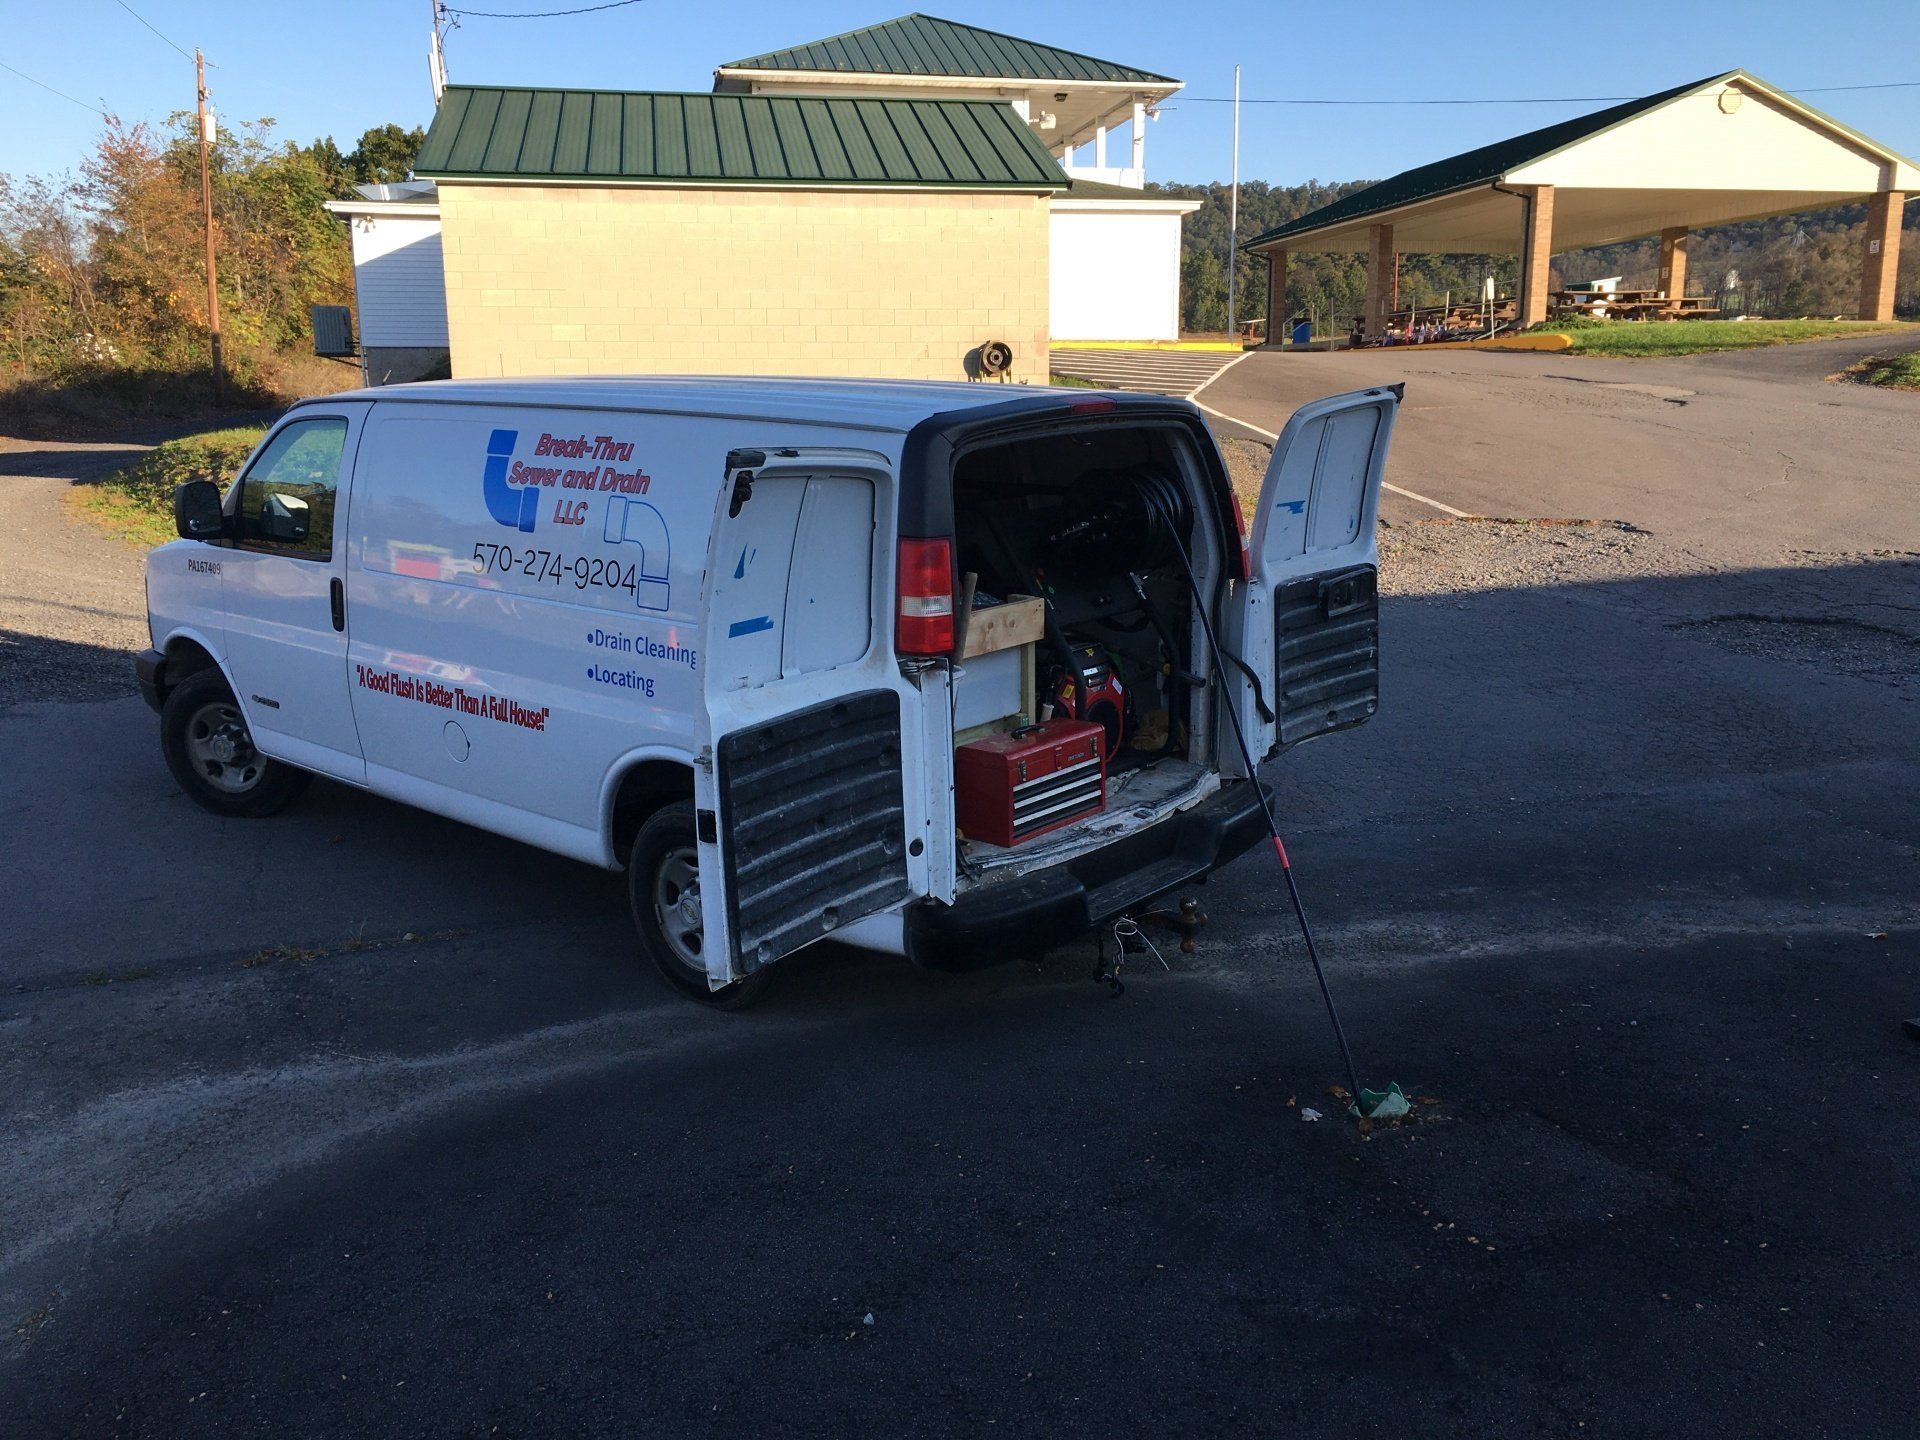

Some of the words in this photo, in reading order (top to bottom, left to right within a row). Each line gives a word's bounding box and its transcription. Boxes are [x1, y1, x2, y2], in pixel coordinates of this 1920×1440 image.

[534, 433, 635, 462] Break-Thru
[508, 461, 561, 486] Sewer
[562, 466, 601, 491] and
[600, 467, 651, 495] Drain
[553, 499, 589, 525] LLC
[472, 542, 637, 597] 570-274-9204
[366, 667, 390, 694] Good
[391, 672, 415, 701] Flush
[416, 678, 424, 703] Is
[425, 681, 454, 710] Better
[455, 687, 479, 716] Than
[480, 694, 489, 718] A
[489, 695, 508, 723] Full
[595, 664, 655, 697] Locating
